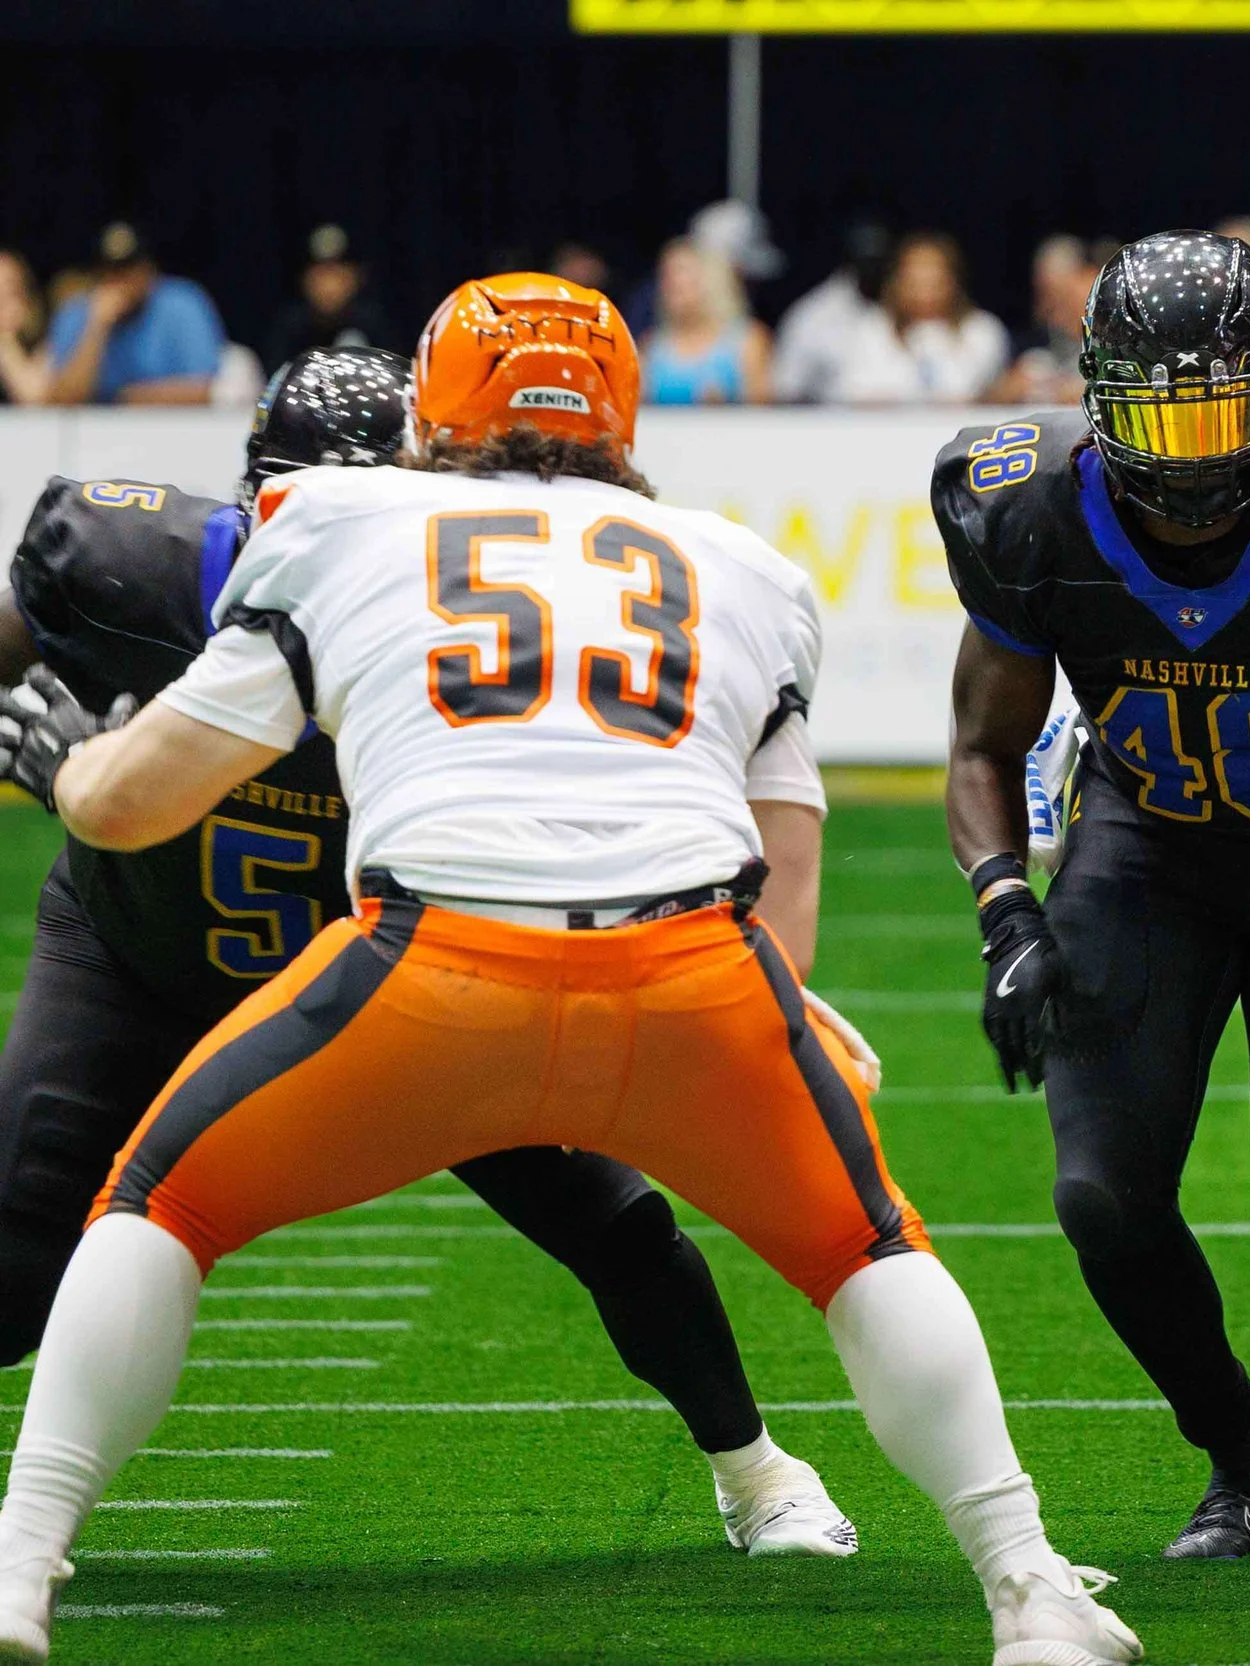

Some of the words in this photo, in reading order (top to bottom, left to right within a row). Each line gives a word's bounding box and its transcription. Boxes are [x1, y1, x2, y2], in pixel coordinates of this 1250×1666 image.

[477, 315, 616, 352] MYTH
[521, 391, 583, 410] XENITH
[967, 422, 1041, 493] 48
[426, 508, 700, 750] 53
[231, 779, 343, 820] SHVILLE
[201, 814, 323, 979] 5
